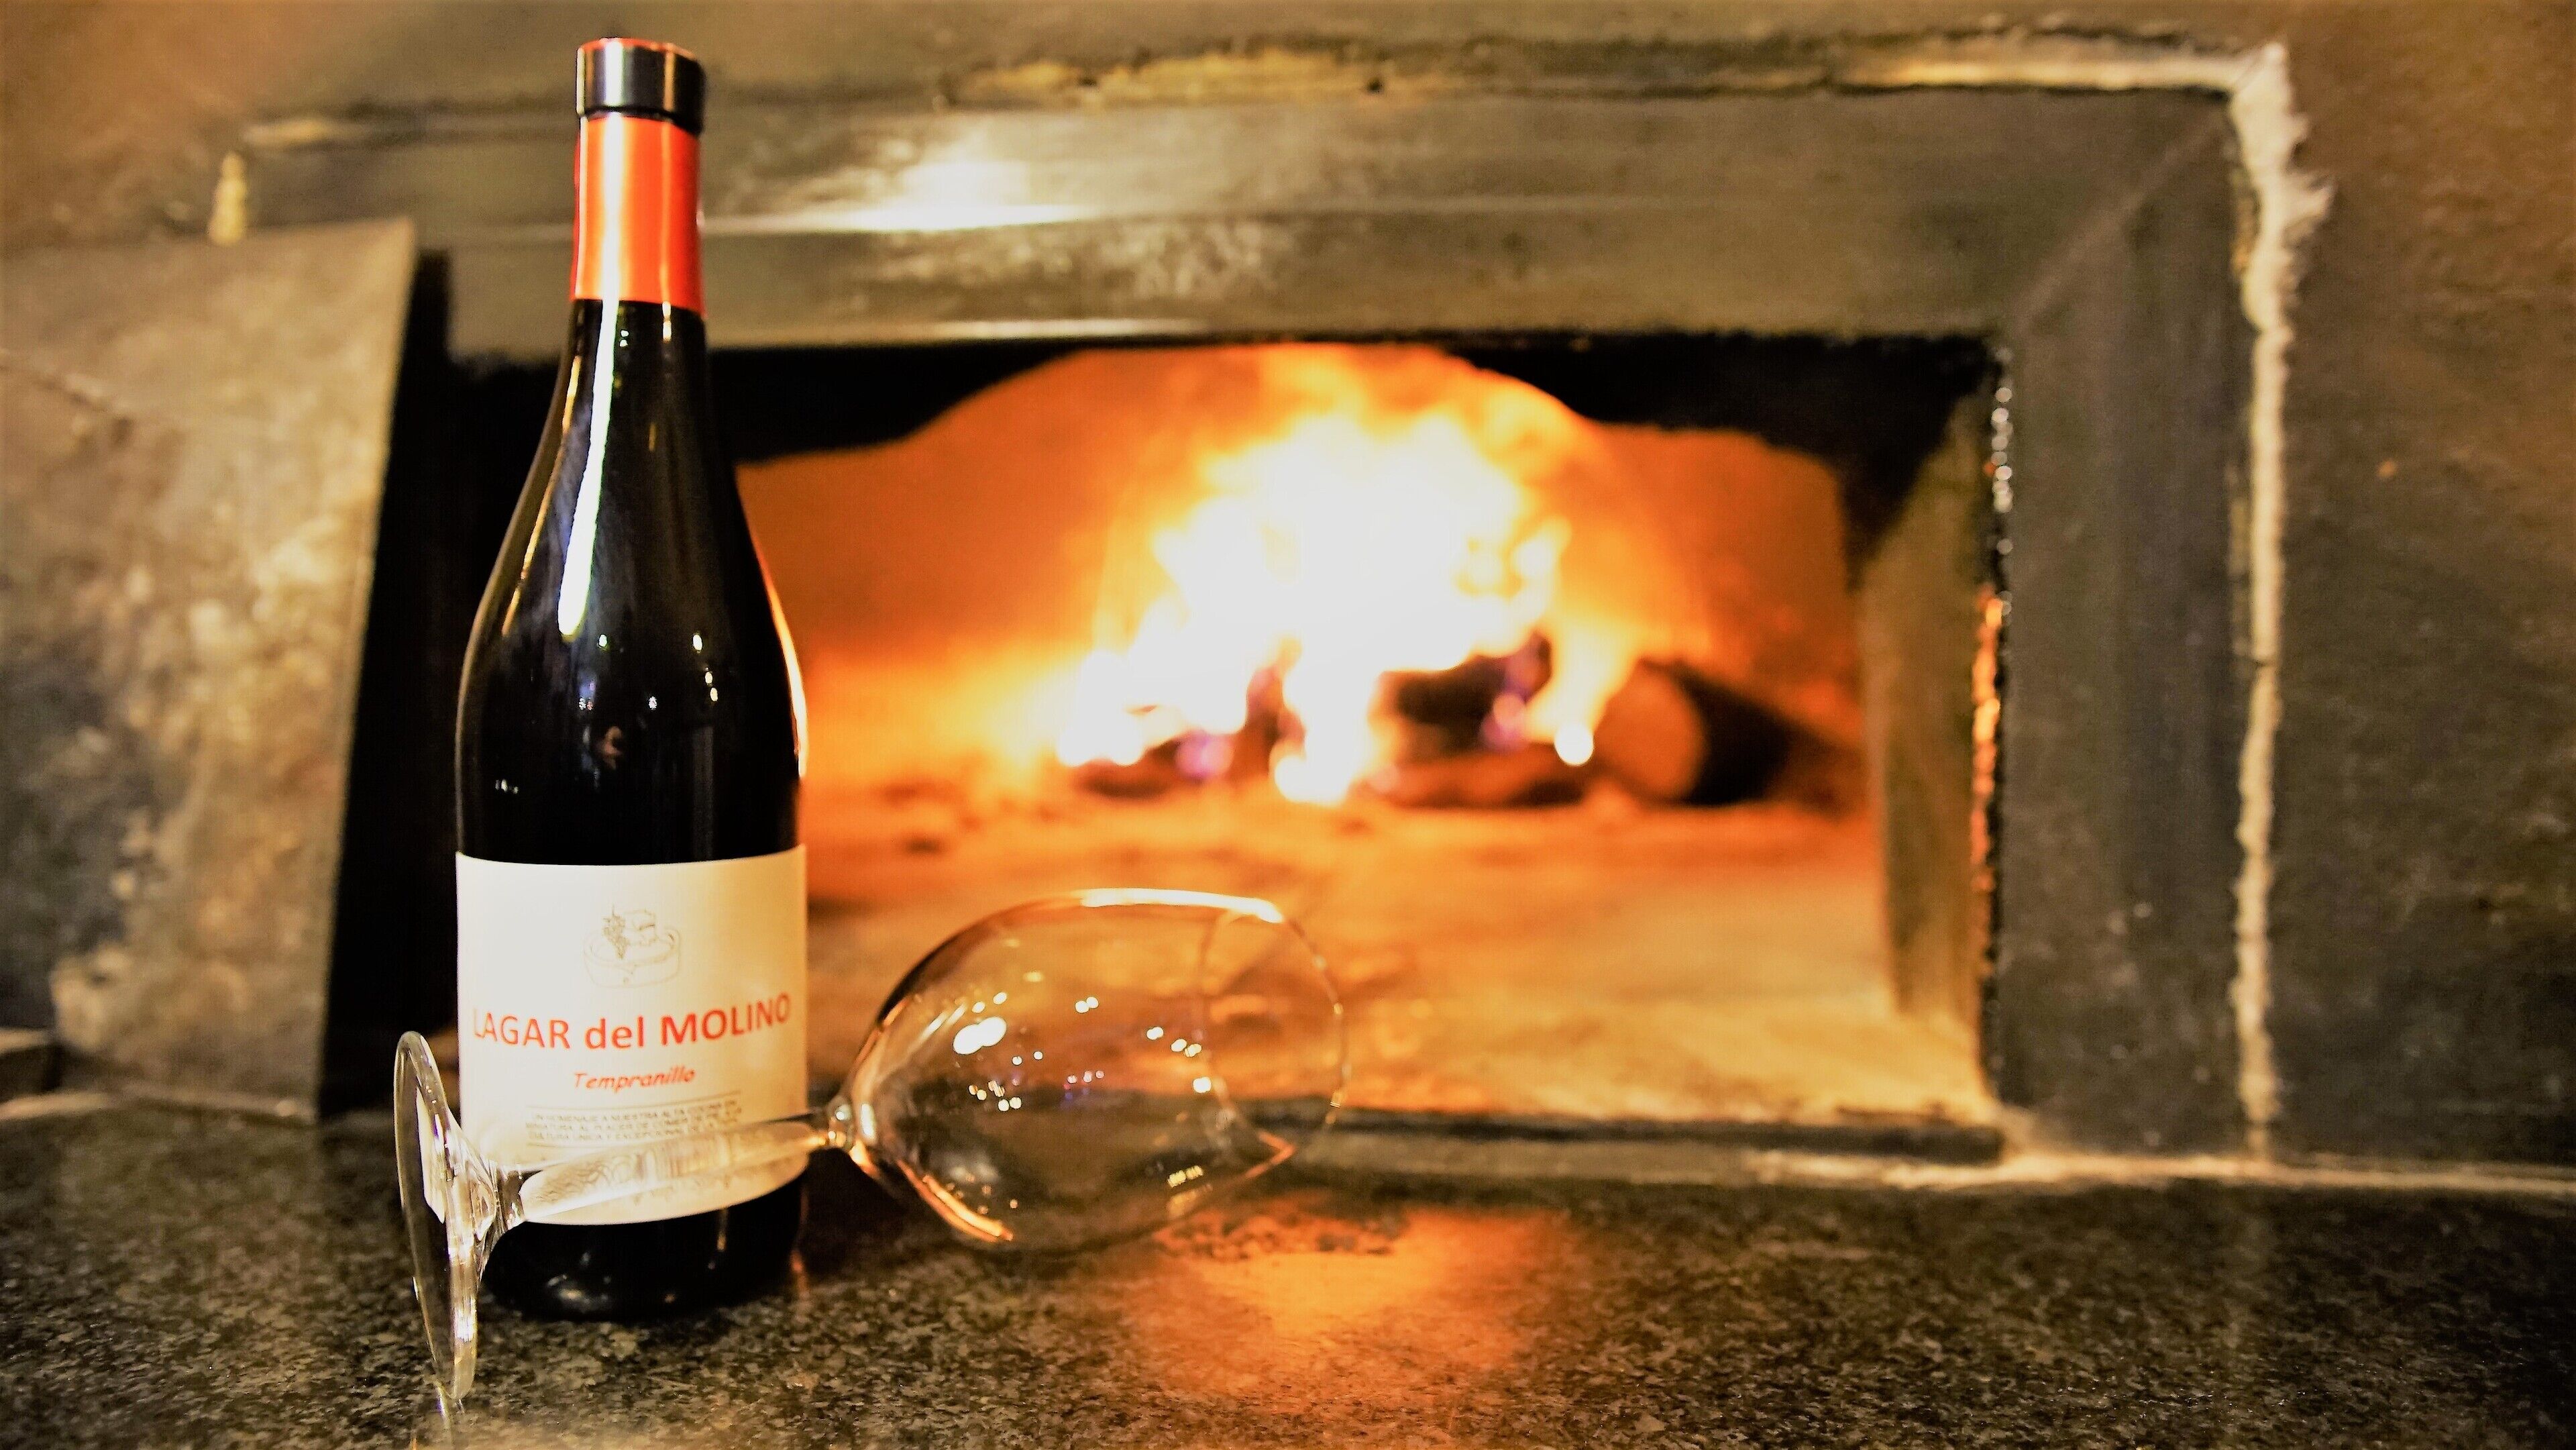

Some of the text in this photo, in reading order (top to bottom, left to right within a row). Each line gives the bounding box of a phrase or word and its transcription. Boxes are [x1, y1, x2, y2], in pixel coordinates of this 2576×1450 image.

[472, 991, 791, 1049] LAGAR del MOLINO
[574, 1066, 696, 1093] Tempranillo
